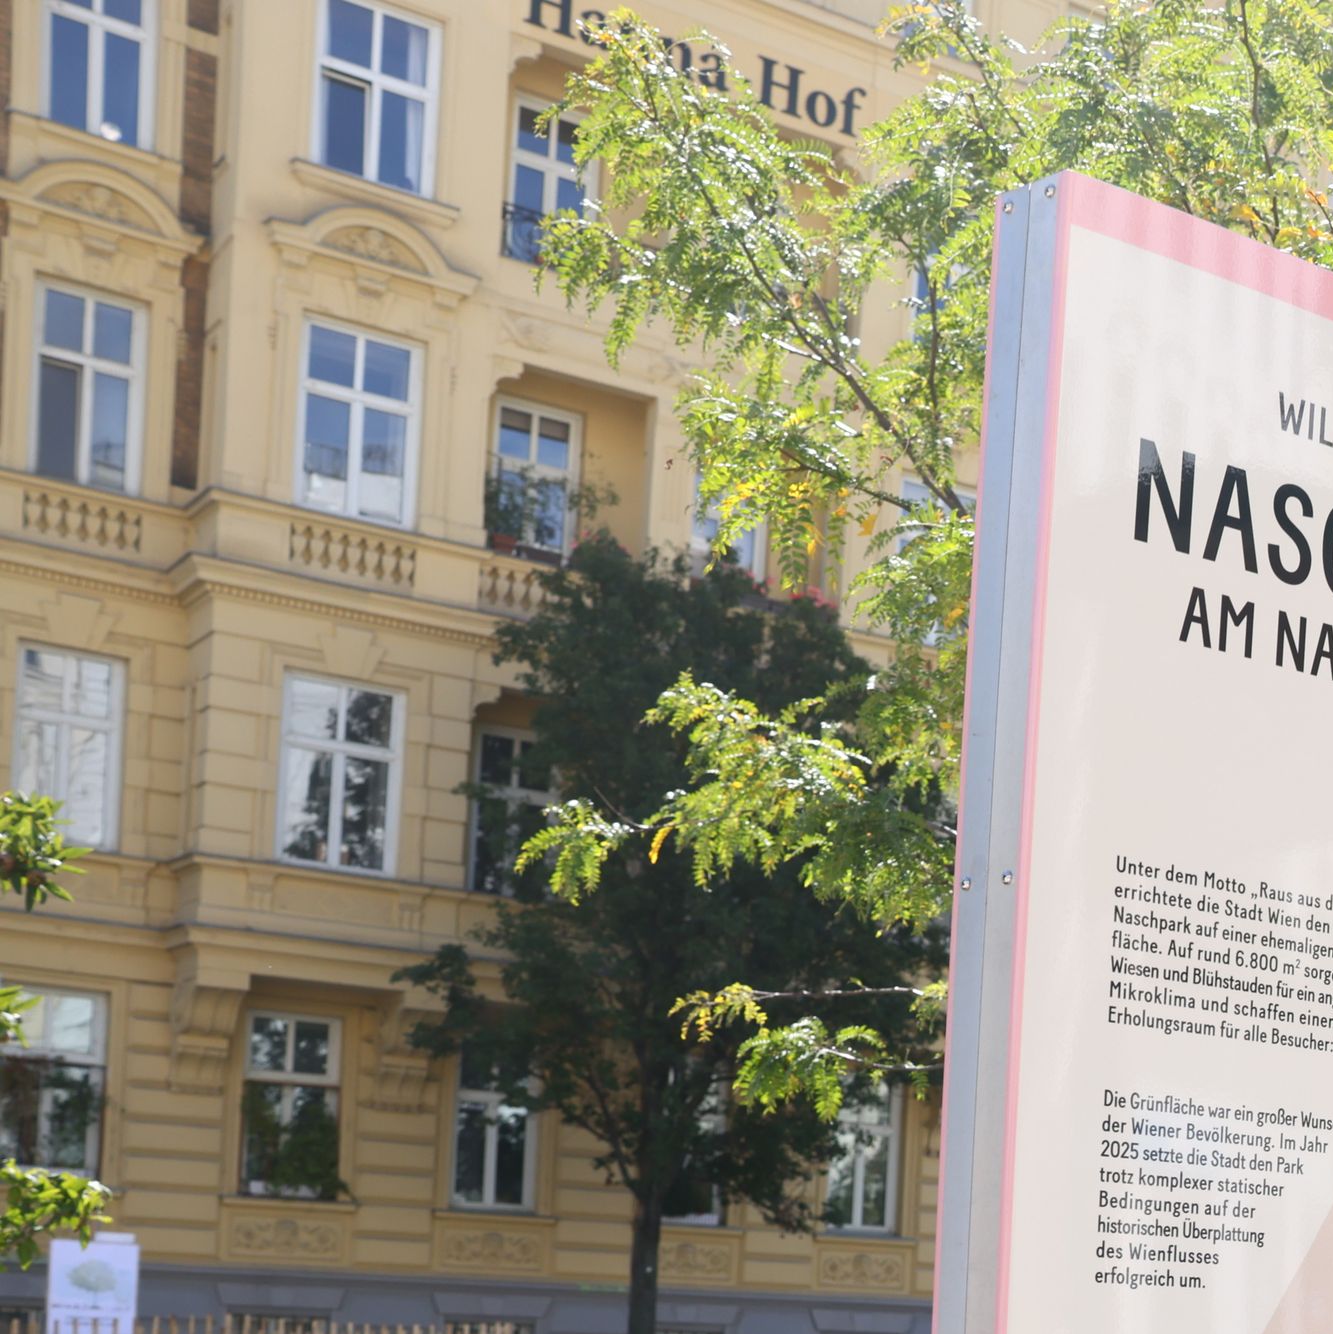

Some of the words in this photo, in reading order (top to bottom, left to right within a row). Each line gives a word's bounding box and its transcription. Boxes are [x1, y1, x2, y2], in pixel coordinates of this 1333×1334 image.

[758, 54, 867, 137] Hof
[1179, 586, 1254, 659] AM
[1116, 855, 1161, 879] Unter
[1165, 864, 1198, 886] dem
[1203, 870, 1246, 895] Motto
[1297, 894, 1321, 909] aus
[1113, 905, 1191, 935] Naschpark
[1195, 921, 1220, 939] auf
[1222, 925, 1258, 945] einer
[1114, 884, 1192, 910] errichtete
[1197, 894, 1220, 914] die
[1224, 899, 1263, 922] Stadt
[1268, 906, 1301, 929] Wien
[1305, 914, 1330, 934] den
[1111, 929, 1162, 955] fläche.
[1167, 939, 1195, 959] Auf
[1197, 947, 1231, 965] rund
[1235, 950, 1278, 972] 6.800
[1110, 955, 1159, 979] Wiesen
[1163, 965, 1189, 983] und
[1192, 967, 1273, 996] Blühstauden
[1276, 980, 1295, 999] für
[1296, 985, 1315, 1002] ein
[1109, 980, 1196, 1009] Mikroklima
[1201, 996, 1229, 1014] und
[1233, 1000, 1295, 1023] schaffen
[1108, 1005, 1216, 1037] Erholungsraum
[1220, 1020, 1240, 1040] für
[1243, 1024, 1267, 1043] alle
[1103, 1089, 1127, 1109] Die
[1130, 1092, 1205, 1117] Grünfläche
[1208, 1106, 1231, 1119] war
[1234, 1105, 1254, 1122] ein
[1256, 1108, 1298, 1127] großer
[1101, 1114, 1127, 1134] der
[1131, 1117, 1182, 1139] Wiener
[1186, 1123, 1275, 1152] Bevölkerung.
[1280, 1132, 1296, 1150] Im
[1299, 1135, 1328, 1153] Jahr
[1100, 1139, 1139, 1160] 2025
[1142, 1147, 1183, 1164] setzte
[1186, 1147, 1208, 1166] die
[1210, 1150, 1246, 1170] Stadt
[1249, 1153, 1273, 1172] den
[1276, 1156, 1304, 1175] Park
[1099, 1167, 1134, 1185] trotz
[1138, 1167, 1214, 1192] komplexer
[1217, 1178, 1285, 1197] statischer
[1098, 1190, 1199, 1221] Bedingungen
[1204, 1199, 1229, 1217] auf
[1232, 1200, 1256, 1219] der
[1097, 1214, 1179, 1238] historischen
[1182, 1218, 1265, 1248] Überplattung
[1096, 1240, 1123, 1259] des
[1129, 1242, 1219, 1265] Wienflusses
[1094, 1266, 1175, 1290] erfolgreich
[1179, 1276, 1206, 1289] um.
